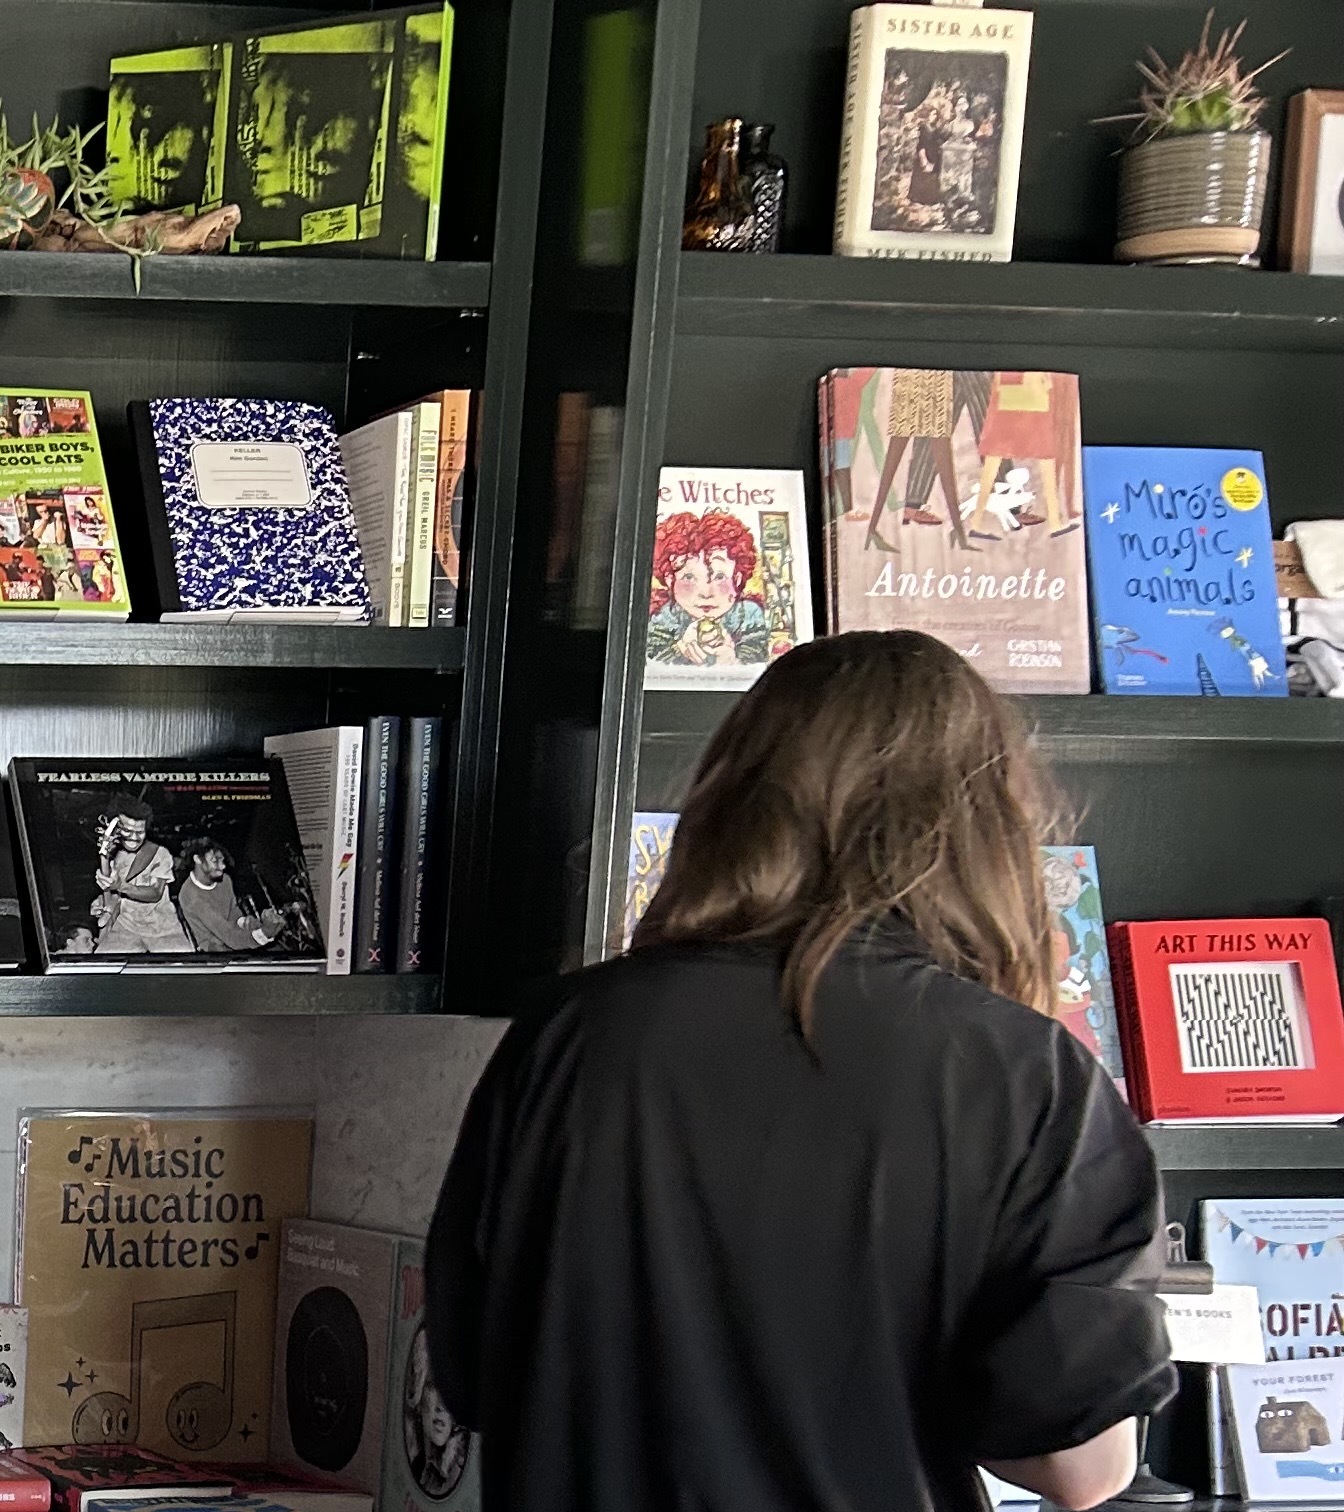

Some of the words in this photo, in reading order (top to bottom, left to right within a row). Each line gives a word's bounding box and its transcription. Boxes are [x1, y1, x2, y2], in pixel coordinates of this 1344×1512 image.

[886, 17, 961, 37] SISTER
[969, 22, 1014, 40] AGE
[0, 443, 45, 454] BIKER
[679, 480, 775, 507] Witches
[1123, 479, 1227, 522] Miró's
[1120, 526, 1233, 572] magic
[864, 560, 1065, 602] Antoinette
[1125, 566, 1255, 607] animals
[1155, 933, 1202, 956] ART
[1208, 932, 1258, 954] THIS
[1265, 930, 1314, 952] WAY
[106, 1136, 226, 1180] Music
[61, 1182, 265, 1225] Education
[82, 1228, 240, 1269] Matters
